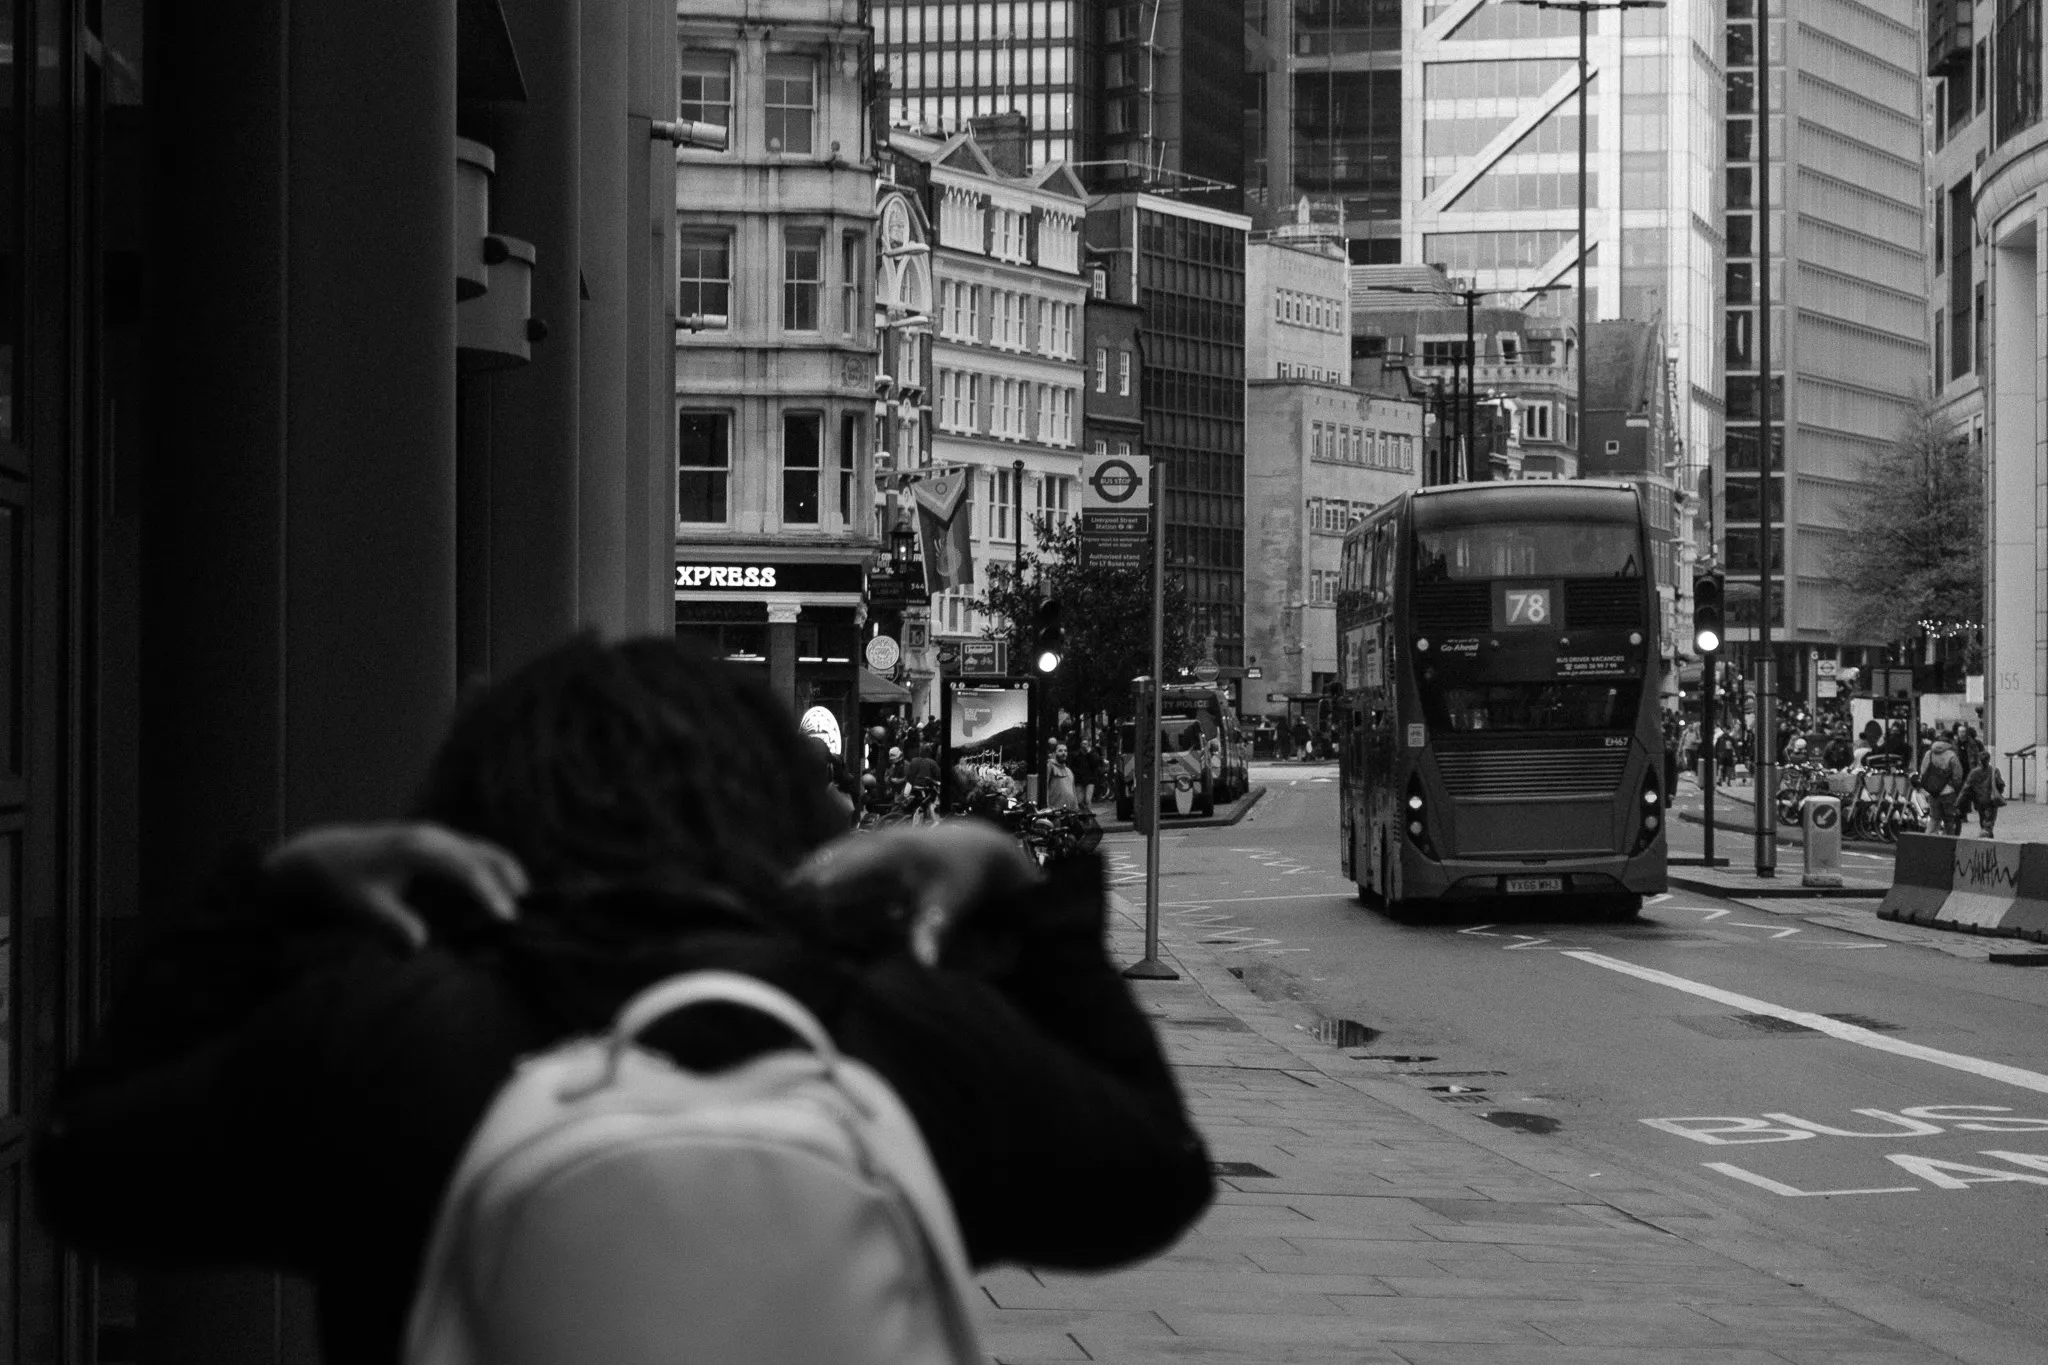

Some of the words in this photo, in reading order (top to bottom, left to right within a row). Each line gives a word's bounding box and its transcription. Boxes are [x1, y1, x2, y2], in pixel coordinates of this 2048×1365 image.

[1090, 516, 1119, 524] Liverpool
[674, 566, 776, 587] XPRESS
[1508, 593, 1545, 622] 78
[1440, 643, 1479, 652] Go-Ahead
[1810, 651, 1819, 660] G
[2000, 672, 2020, 690] 155
[1176, 699, 1209, 709] POLICE
[1605, 737, 1628, 746] EH67
[1637, 1105, 2048, 1145] BUS
